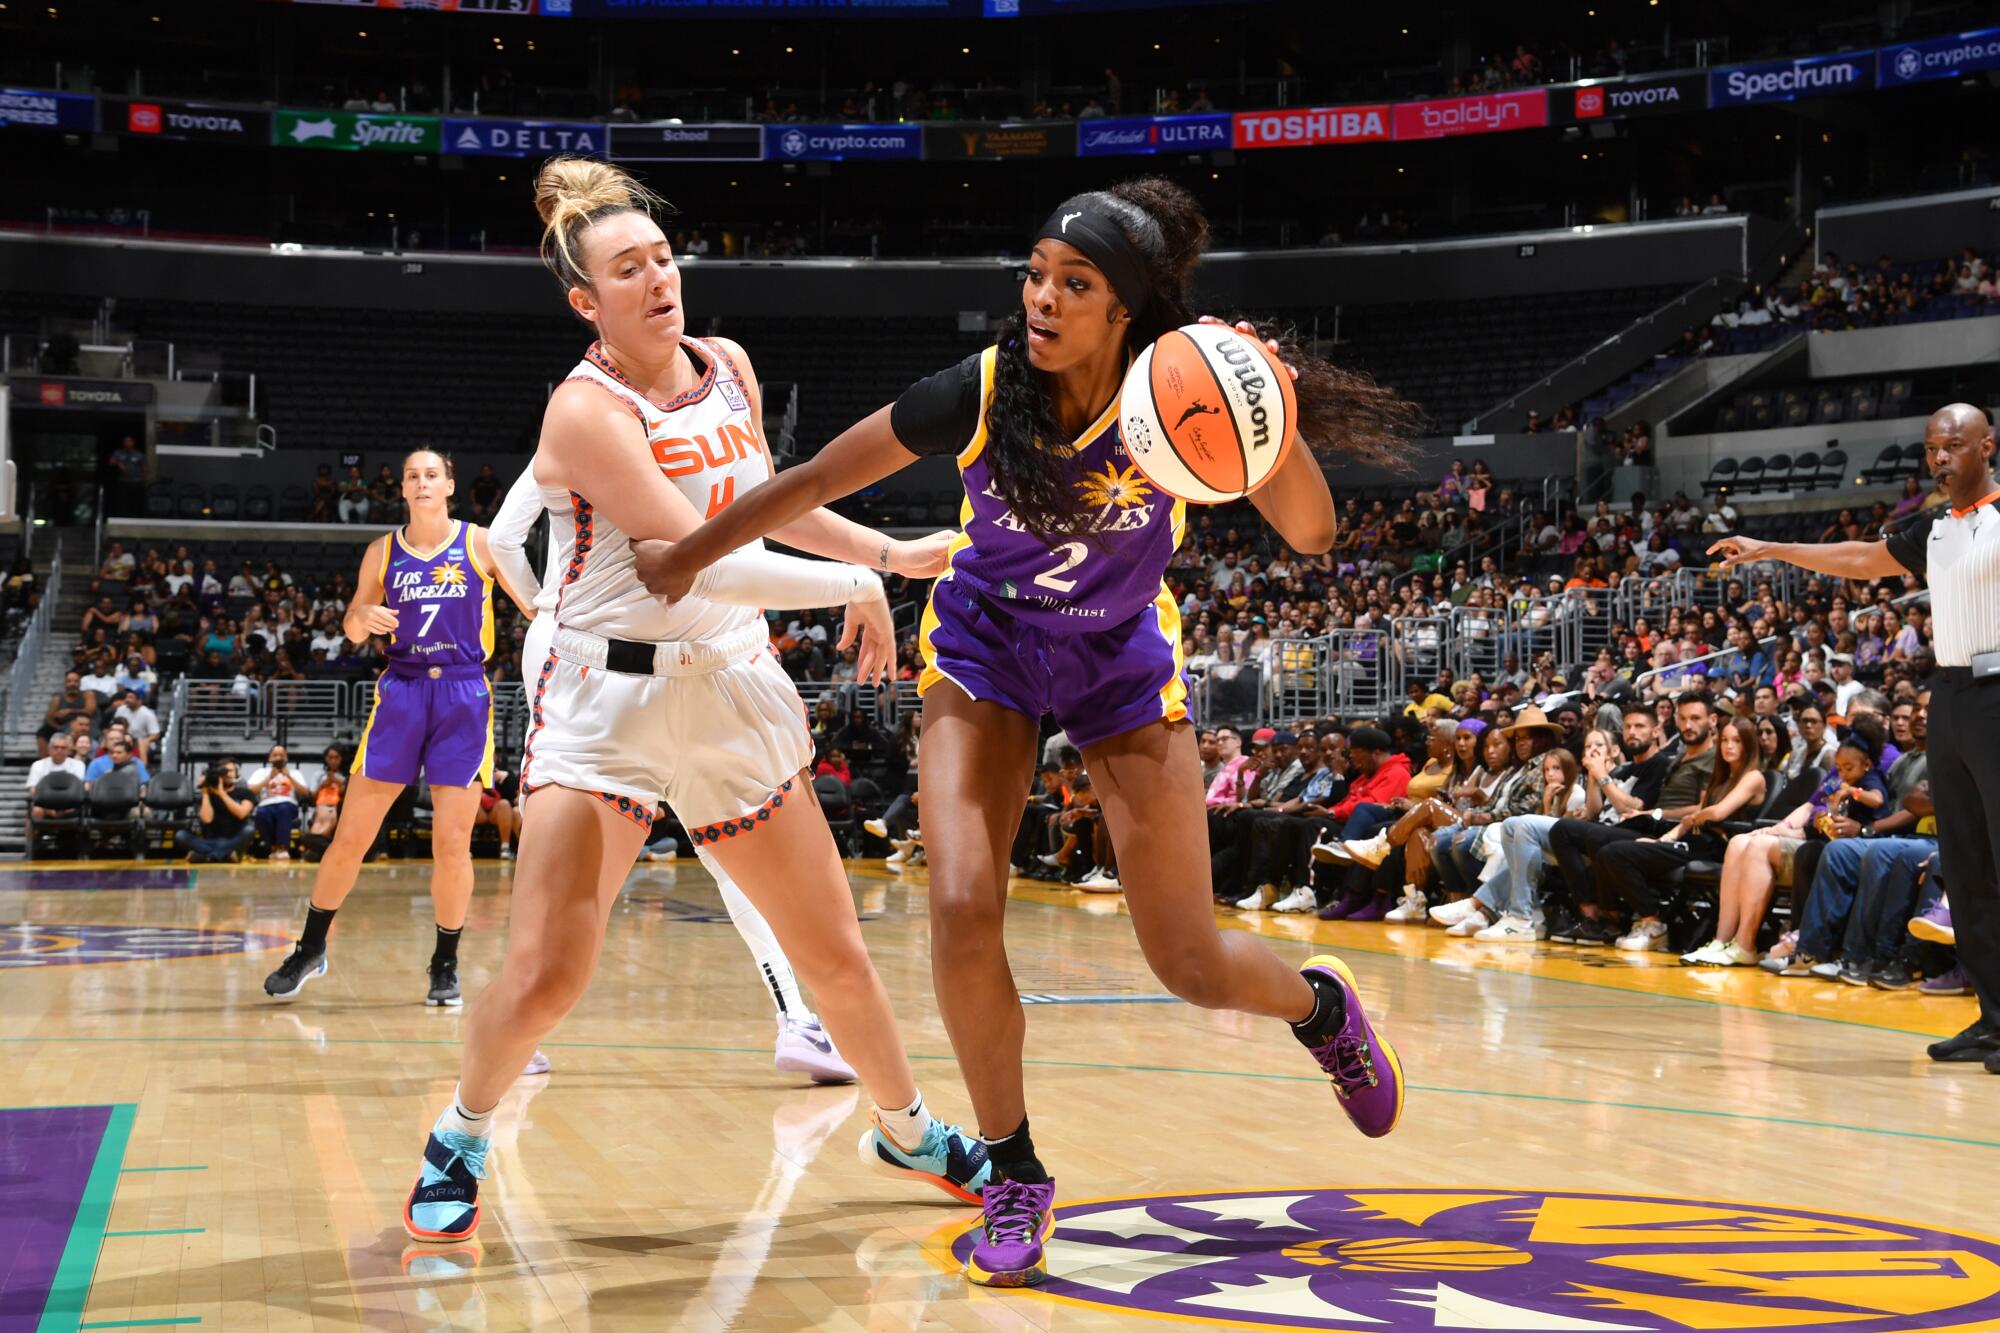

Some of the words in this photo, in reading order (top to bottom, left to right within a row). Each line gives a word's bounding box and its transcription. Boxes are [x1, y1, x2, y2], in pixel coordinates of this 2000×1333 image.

[1924, 42, 2000, 66] crypto.c
[1727, 62, 1853, 101] Spectrum
[1609, 86, 1680, 107] TOYOTA
[166, 113, 243, 133] TOYOTA
[1421, 101, 1520, 128] boldyn
[351, 118, 426, 147] Sprite
[662, 129, 709, 142] School
[1161, 124, 1225, 143] ULTRA
[1240, 111, 1385, 142] TOSHIBA
[490, 128, 595, 151] DELTA
[809, 133, 906, 150] crypto.com
[68, 390, 122, 402] TOYOTA
[1216, 337, 1269, 451] Wilson
[651, 419, 762, 478] SUN
[1033, 541, 1089, 593] 2
[392, 571, 423, 589] LOS
[398, 584, 468, 603] ANGELES
[417, 603, 441, 638] 7
